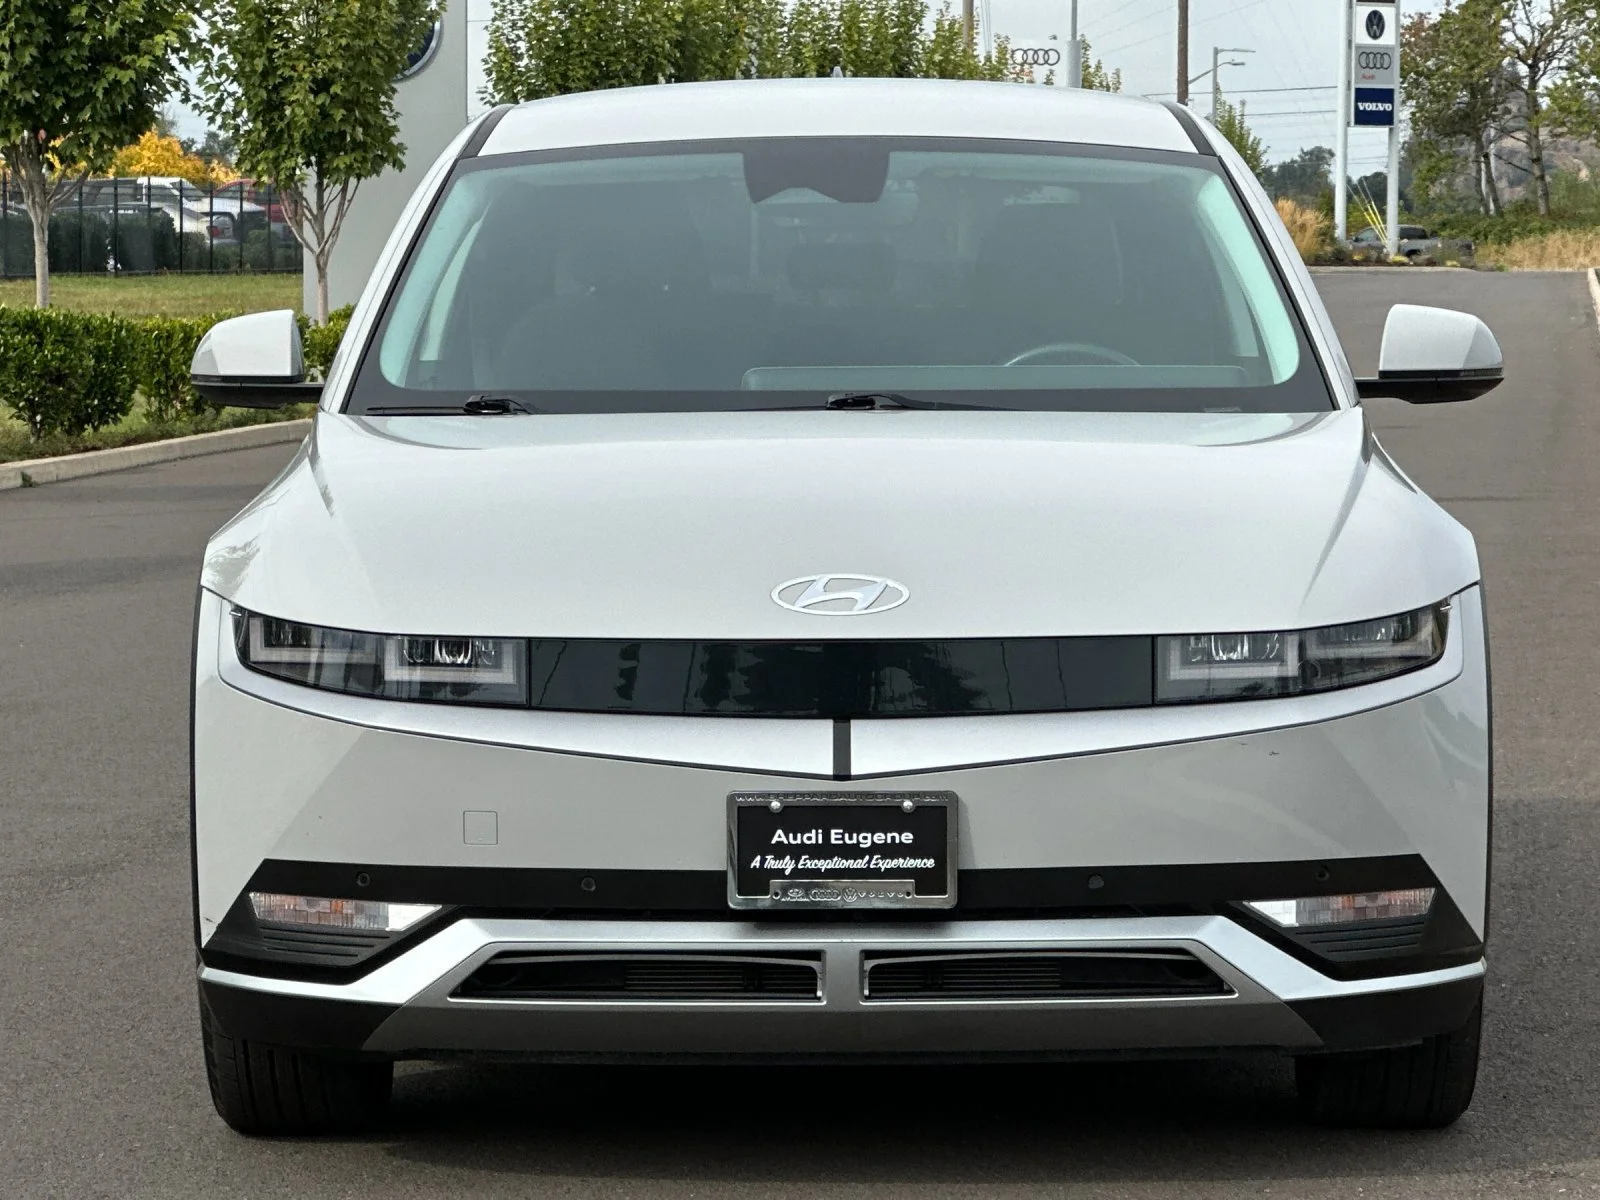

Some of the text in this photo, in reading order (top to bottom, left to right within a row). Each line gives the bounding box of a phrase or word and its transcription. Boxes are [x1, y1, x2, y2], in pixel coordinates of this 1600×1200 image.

[1357, 102, 1392, 111] VOLVO
[771, 829, 914, 848] Audi Eugene
[750, 855, 935, 875] A Truly Exceptional Experience
